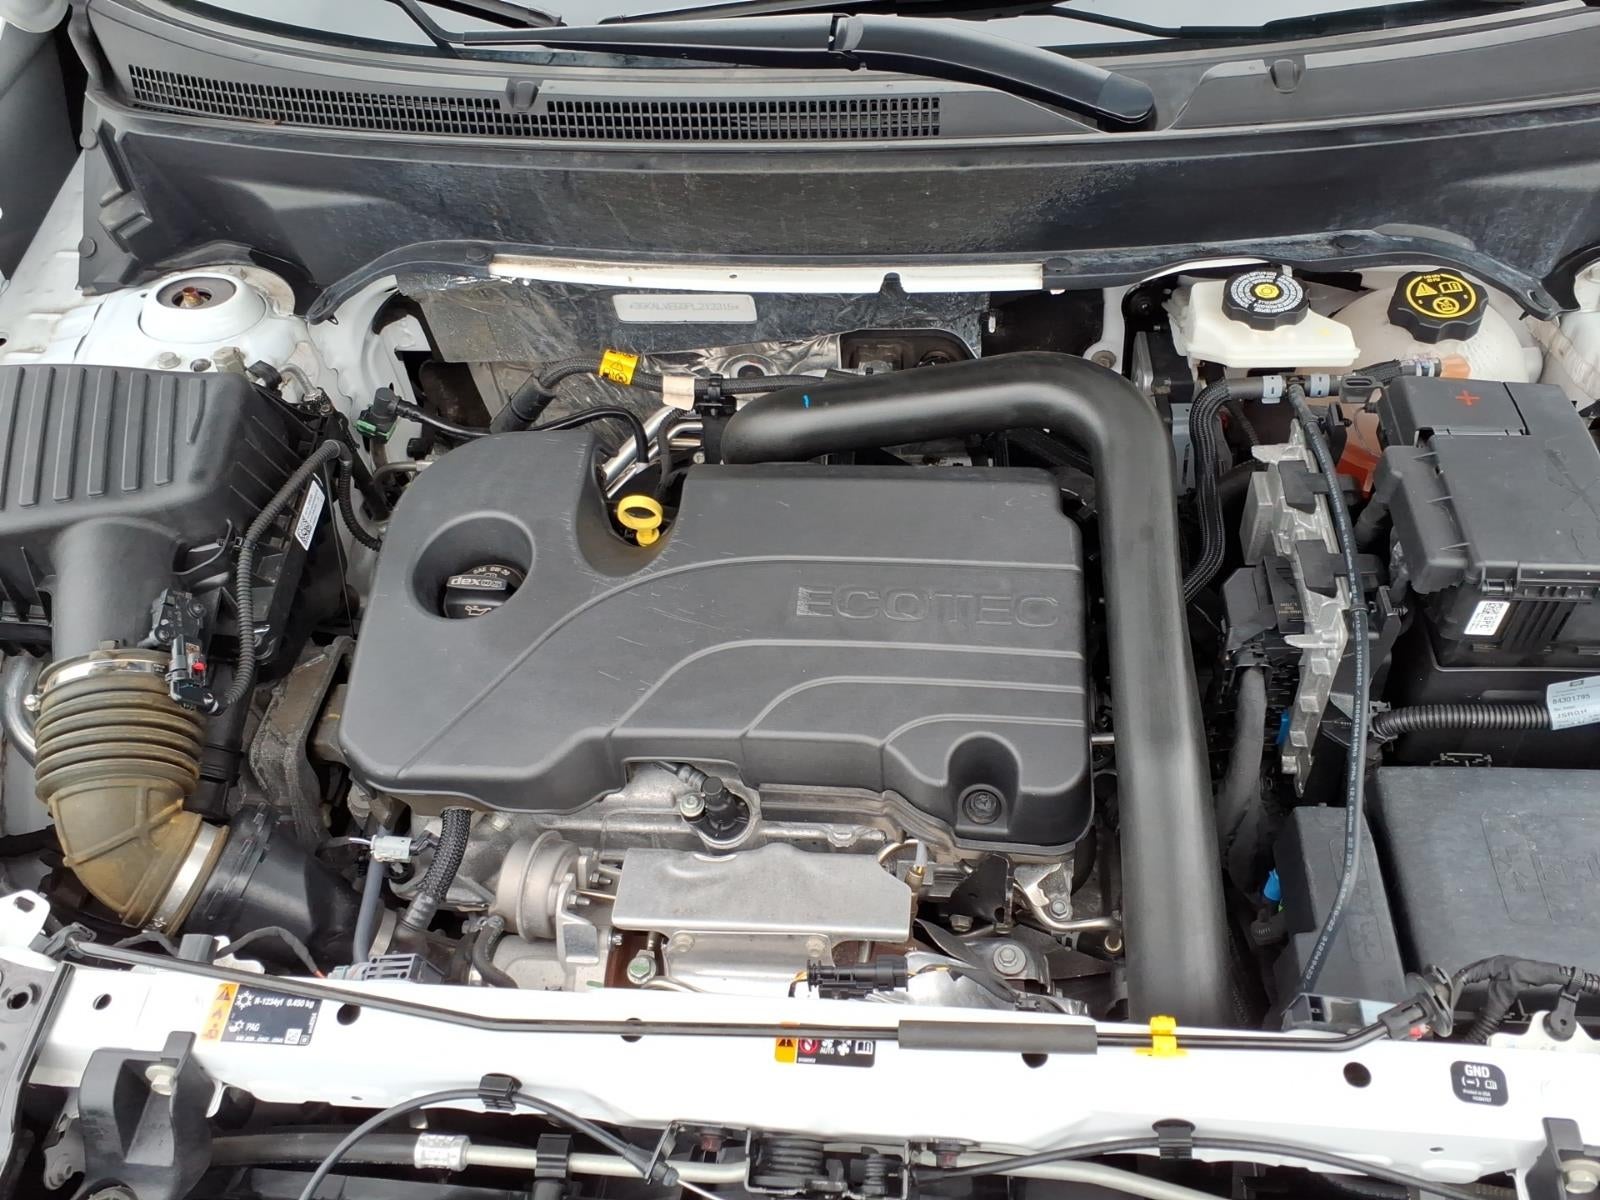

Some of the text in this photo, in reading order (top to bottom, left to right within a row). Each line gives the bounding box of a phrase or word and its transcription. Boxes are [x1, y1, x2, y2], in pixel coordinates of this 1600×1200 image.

[796, 586, 1060, 628] ECOTEC
[245, 1022, 260, 1032] PAG
[1464, 1064, 1490, 1078] GND
